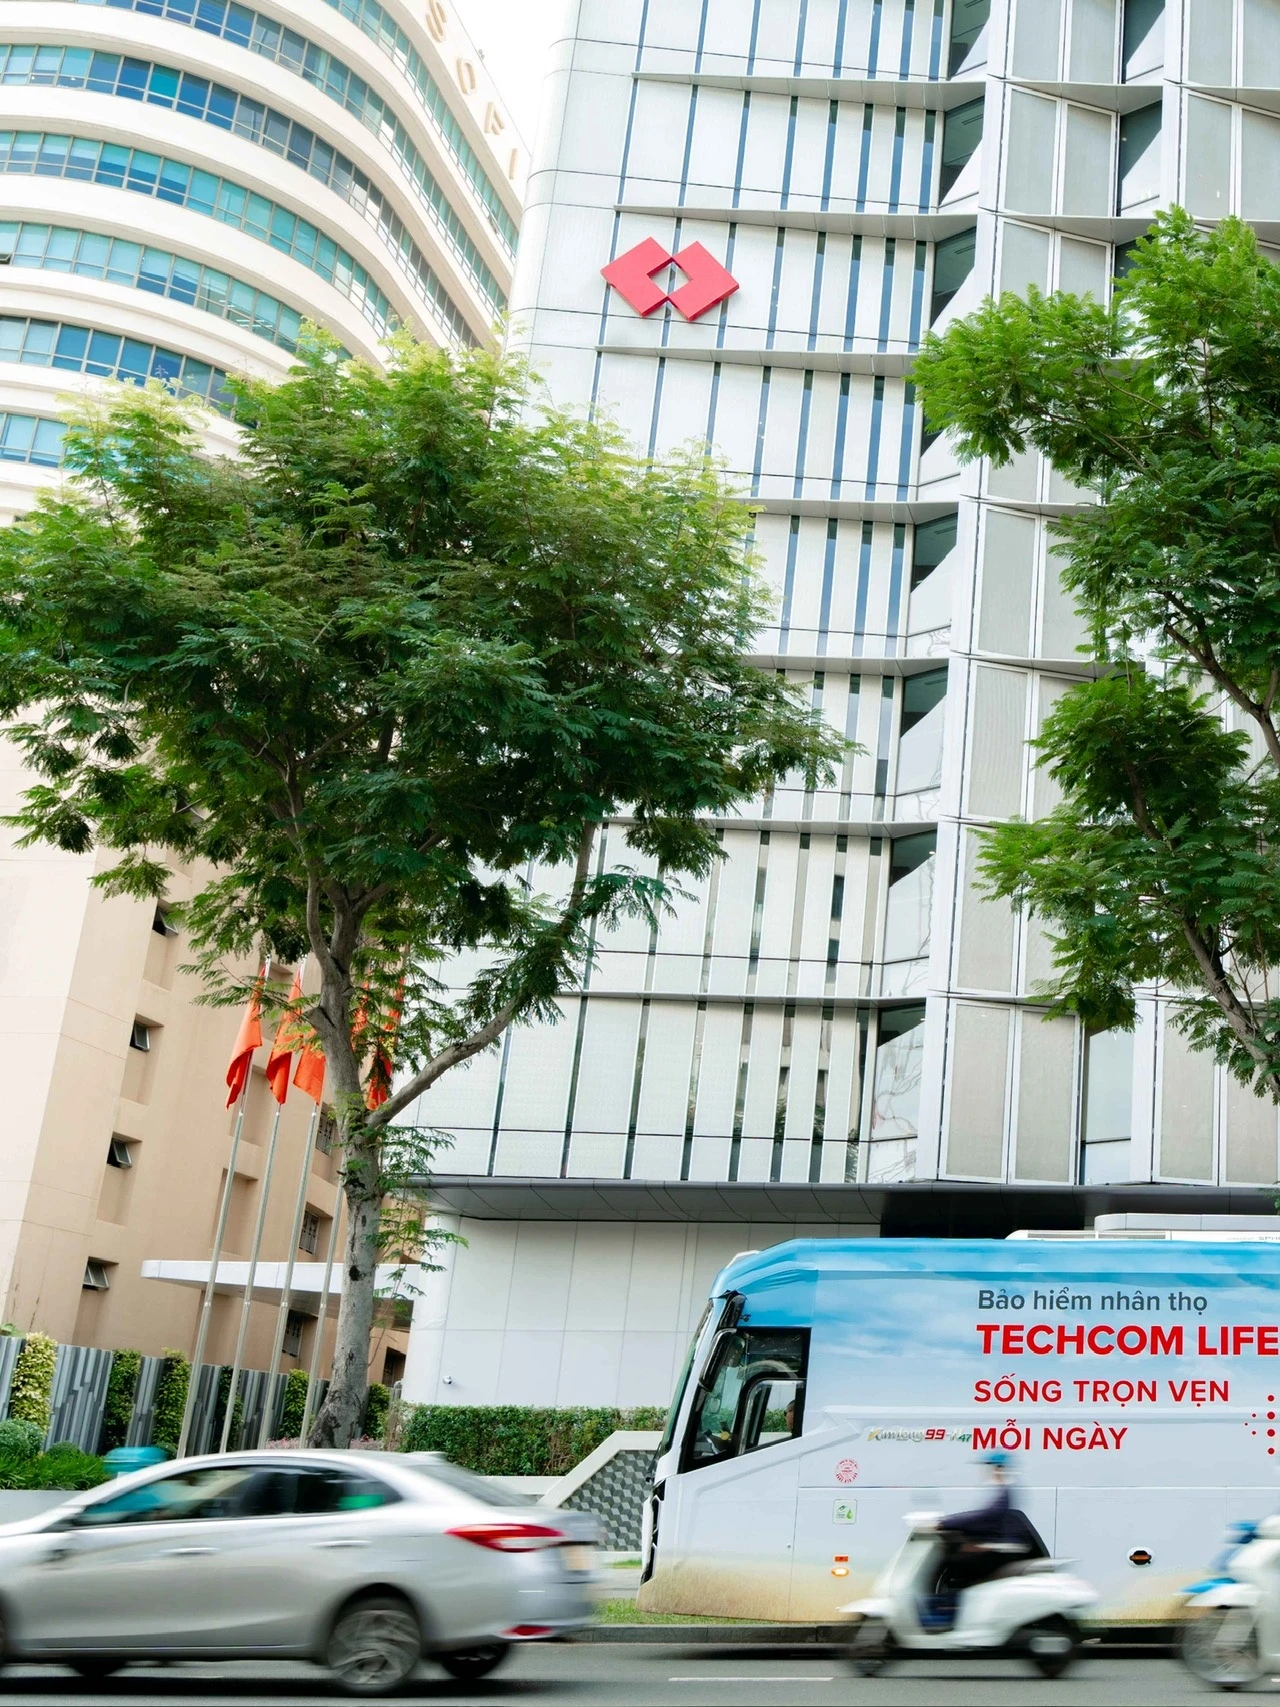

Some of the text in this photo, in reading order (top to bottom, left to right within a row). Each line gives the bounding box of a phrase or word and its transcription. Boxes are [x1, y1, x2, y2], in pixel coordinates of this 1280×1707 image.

[977, 1286, 1208, 1316] Bảo hiểm nhân thọ
[976, 1324, 1279, 1356] TECHCOM LIFE
[973, 1372, 1229, 1408] SỐNG TRỌN VẸN
[972, 1419, 1129, 1451] MỖI NGÀY
